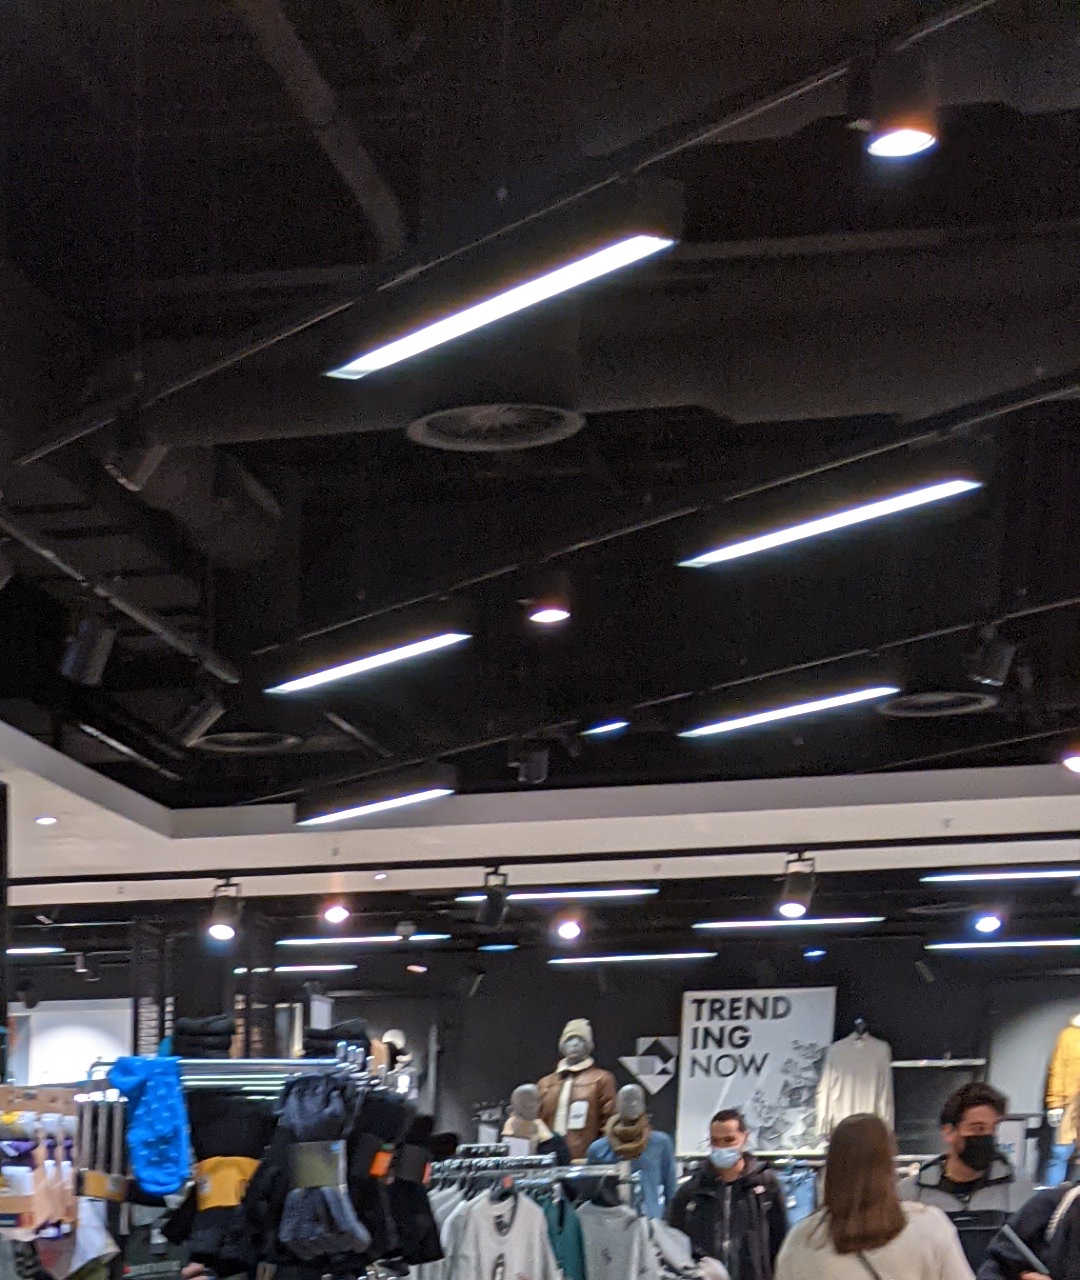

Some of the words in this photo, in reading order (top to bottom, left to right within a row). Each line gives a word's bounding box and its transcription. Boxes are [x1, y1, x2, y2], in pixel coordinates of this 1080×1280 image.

[691, 996, 792, 1021] TREND
[690, 1025, 752, 1049] ING
[689, 1052, 770, 1078] NOW
